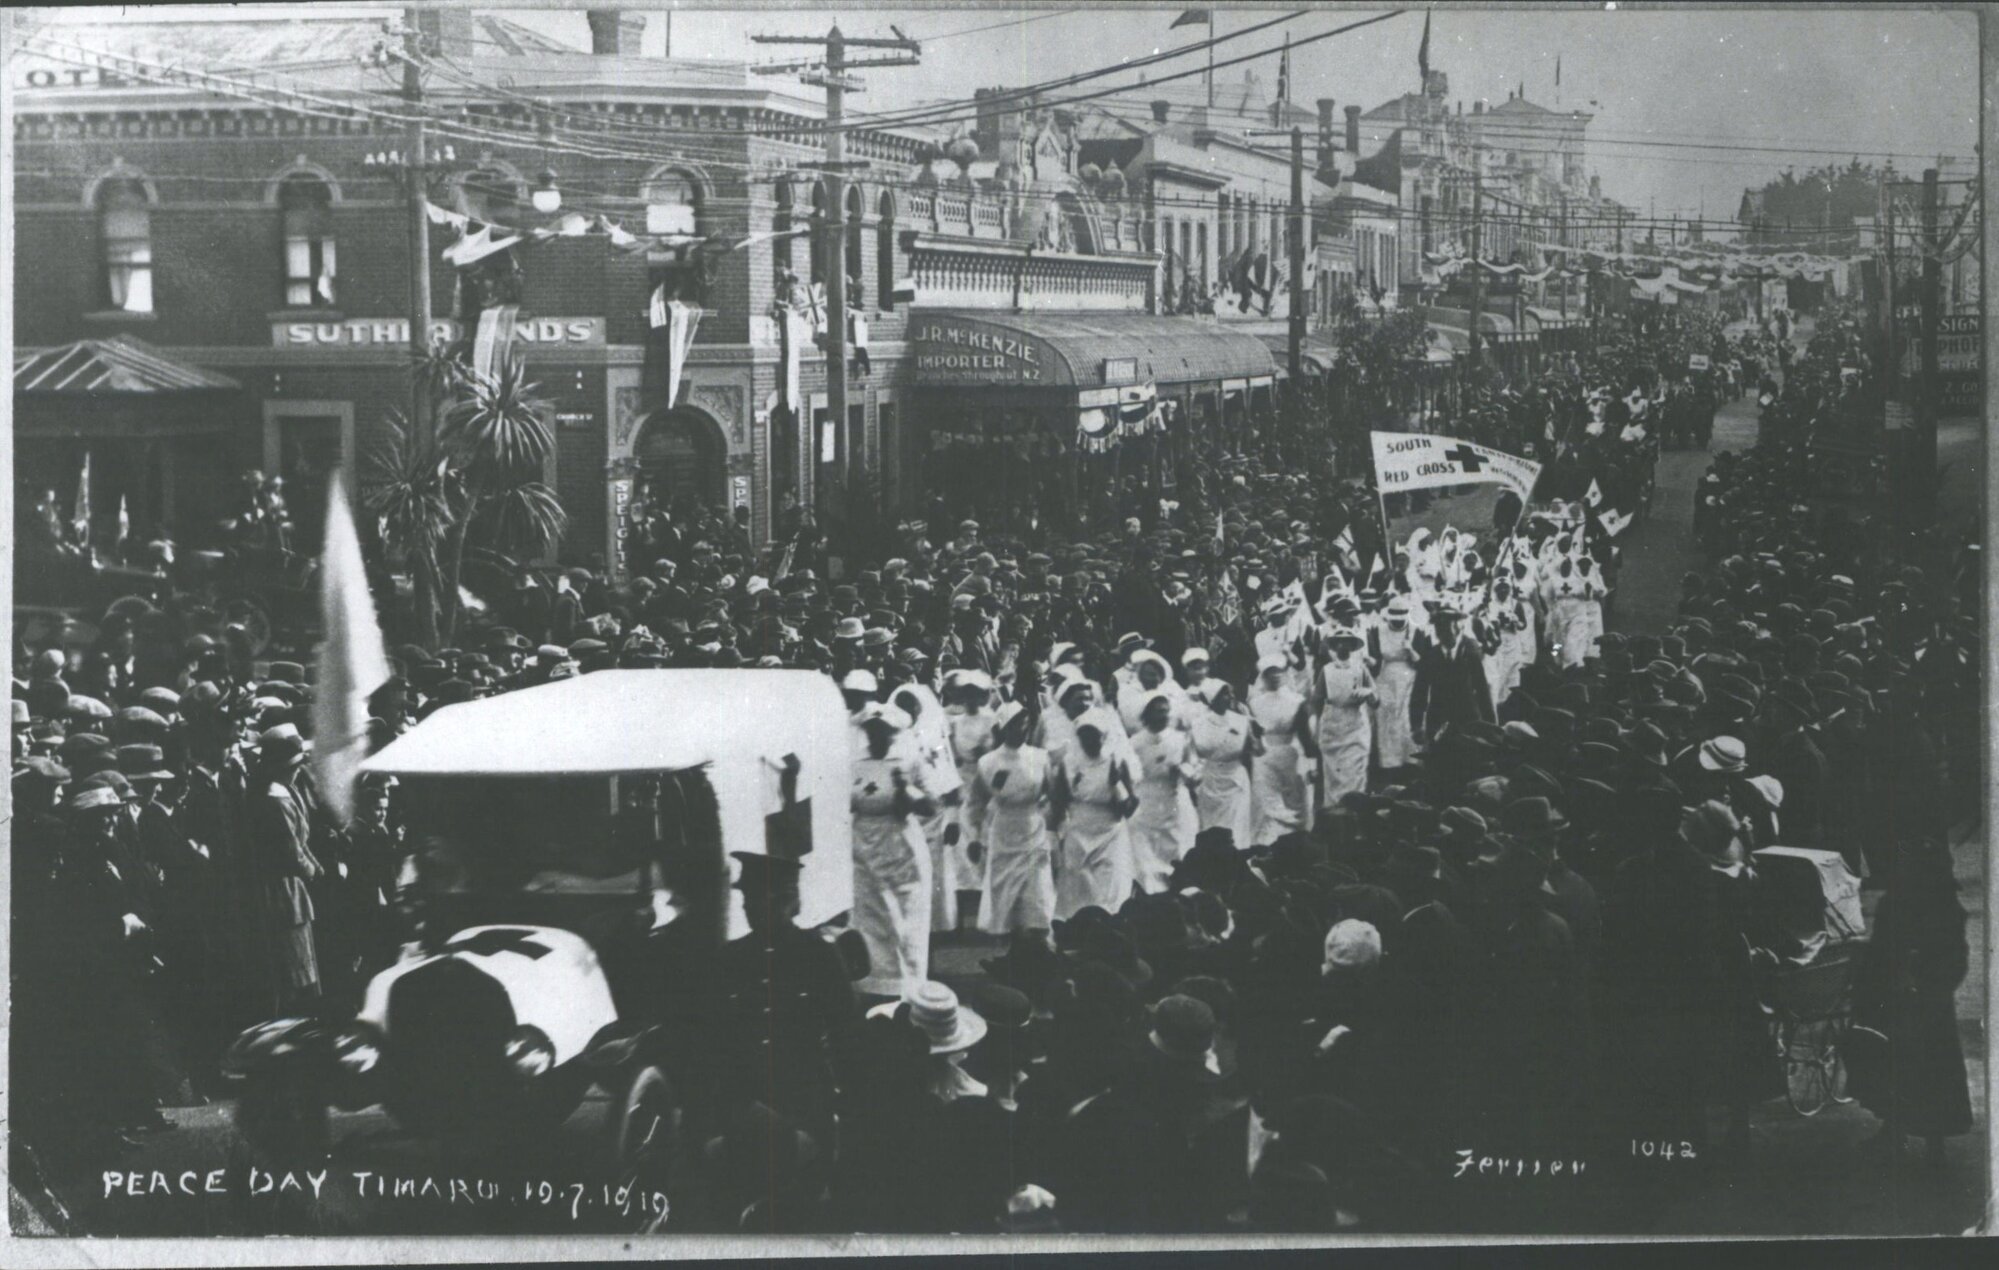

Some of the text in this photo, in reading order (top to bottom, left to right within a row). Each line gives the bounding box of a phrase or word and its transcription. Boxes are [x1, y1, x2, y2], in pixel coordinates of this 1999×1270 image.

[1387, 438, 1432, 454] SOUTH
[1384, 462, 1456, 483] RED CROSS
